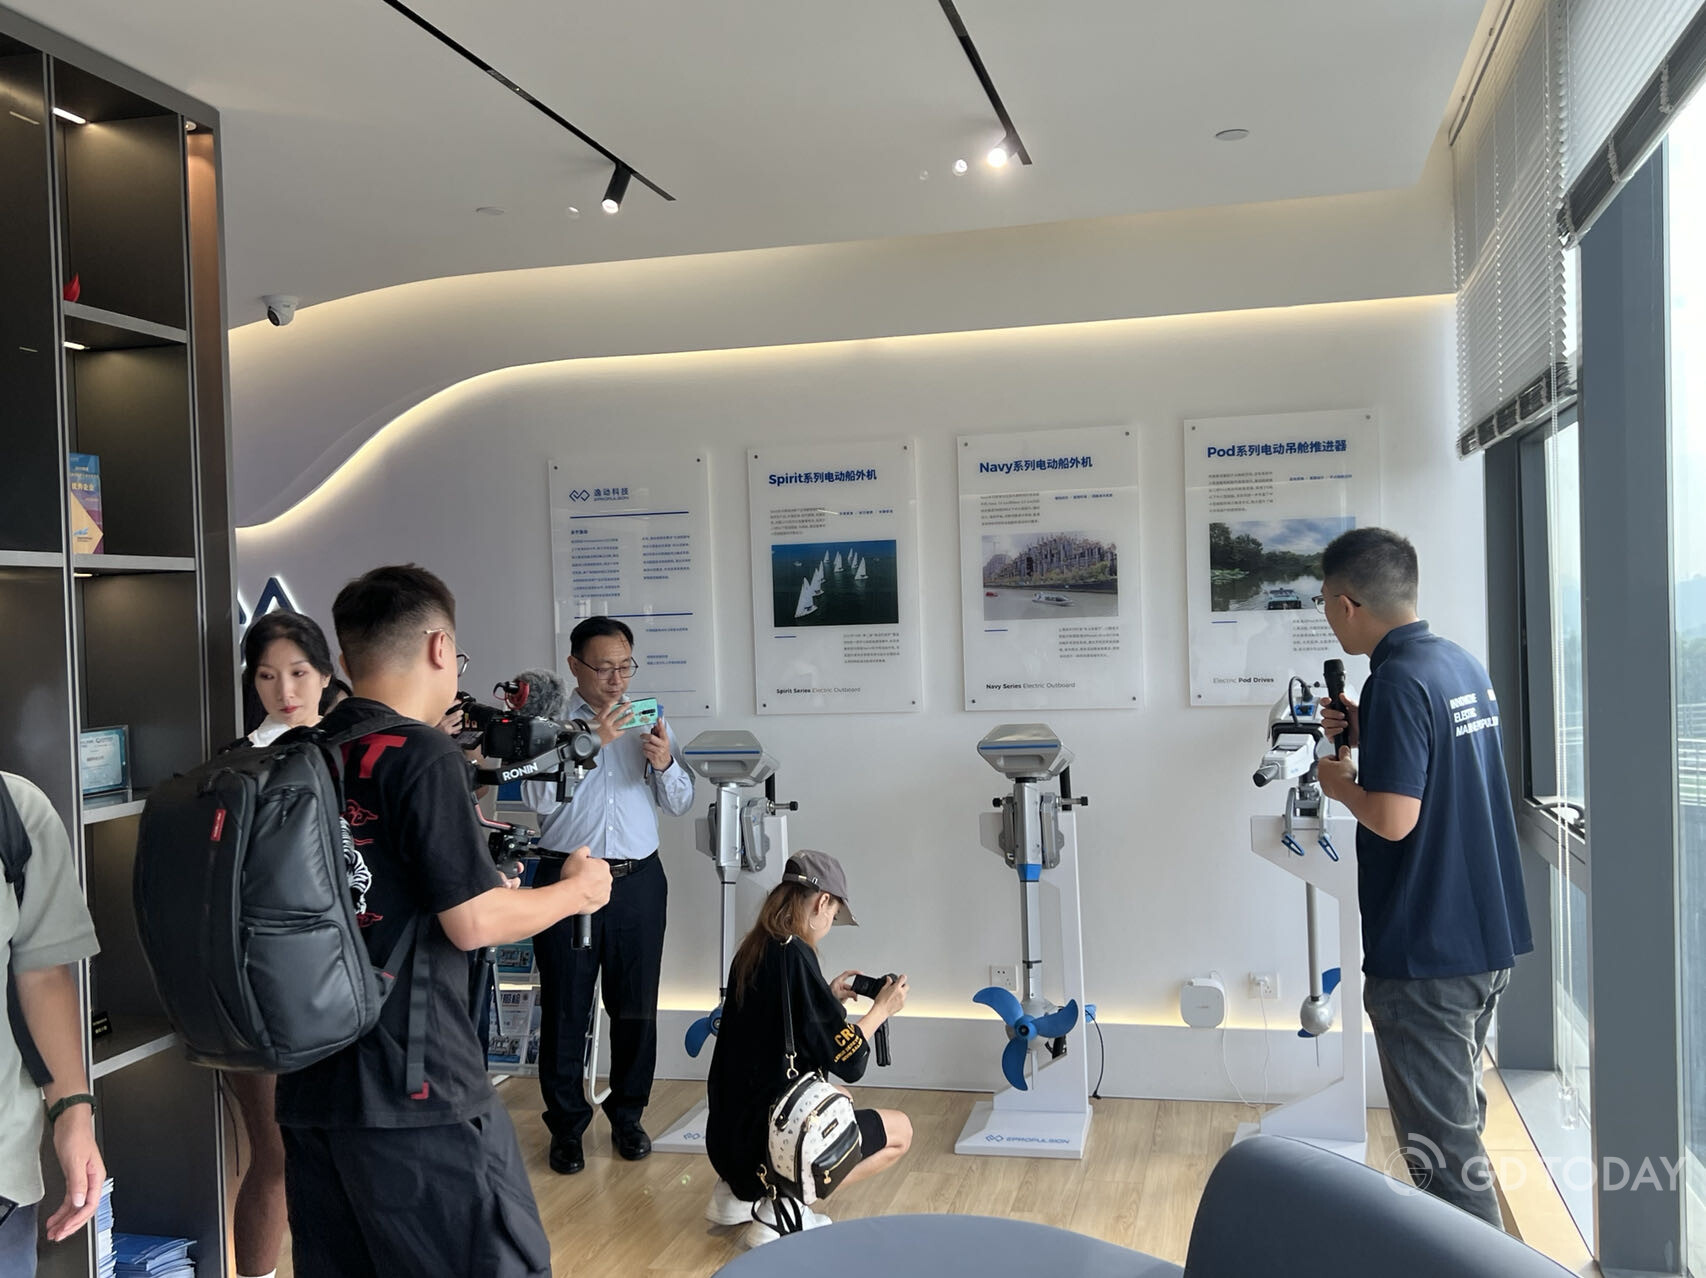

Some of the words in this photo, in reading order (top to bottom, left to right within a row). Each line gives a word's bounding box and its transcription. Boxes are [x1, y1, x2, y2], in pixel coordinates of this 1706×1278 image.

[1207, 439, 1347, 458] Pod系列电动吊舱推进器
[979, 456, 1093, 475] Navy系列电动船外机
[768, 469, 877, 486] Spirit系列电动船外机
[776, 687, 792, 695] Spirit
[1046, 681, 1076, 689] Outboard
[502, 762, 539, 781] RONIN
